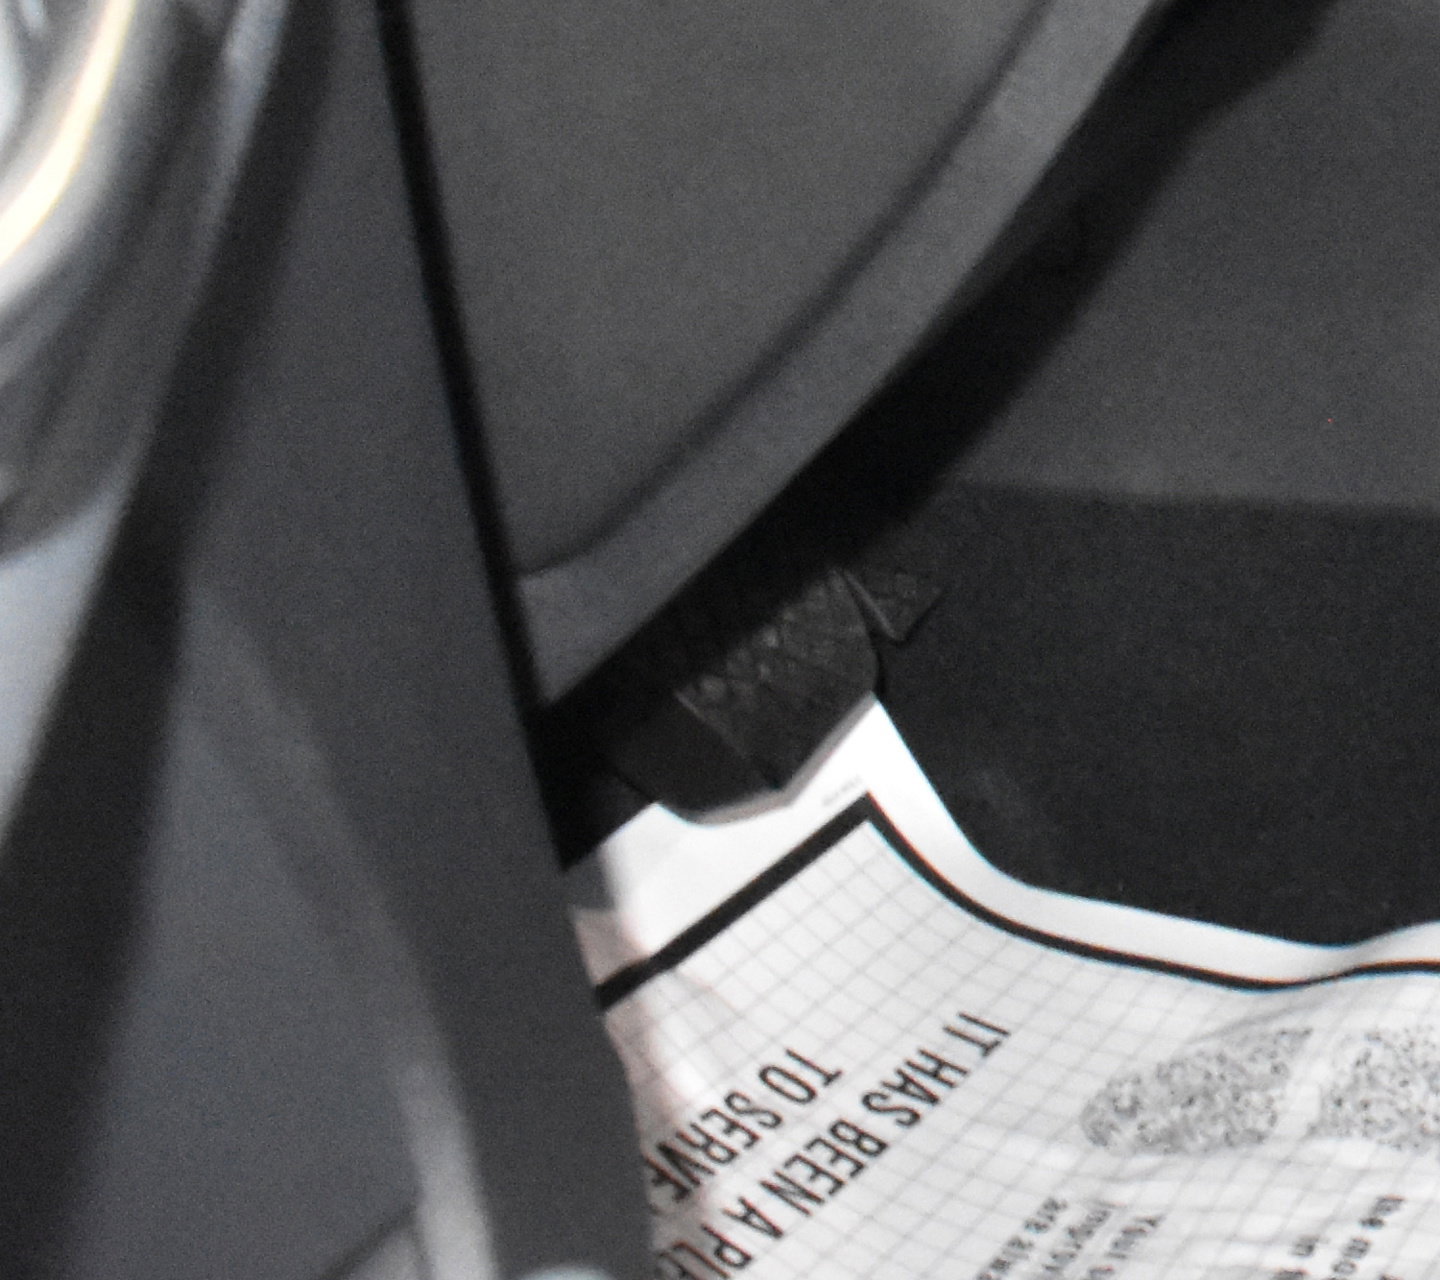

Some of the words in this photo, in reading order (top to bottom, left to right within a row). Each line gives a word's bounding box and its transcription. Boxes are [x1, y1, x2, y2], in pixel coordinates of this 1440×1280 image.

[942, 1011, 1012, 1058] IT
[758, 1047, 843, 1106] TO
[860, 1048, 970, 1129] HAS
[759, 1117, 890, 1218] BEEN
[722, 1195, 784, 1239] A
